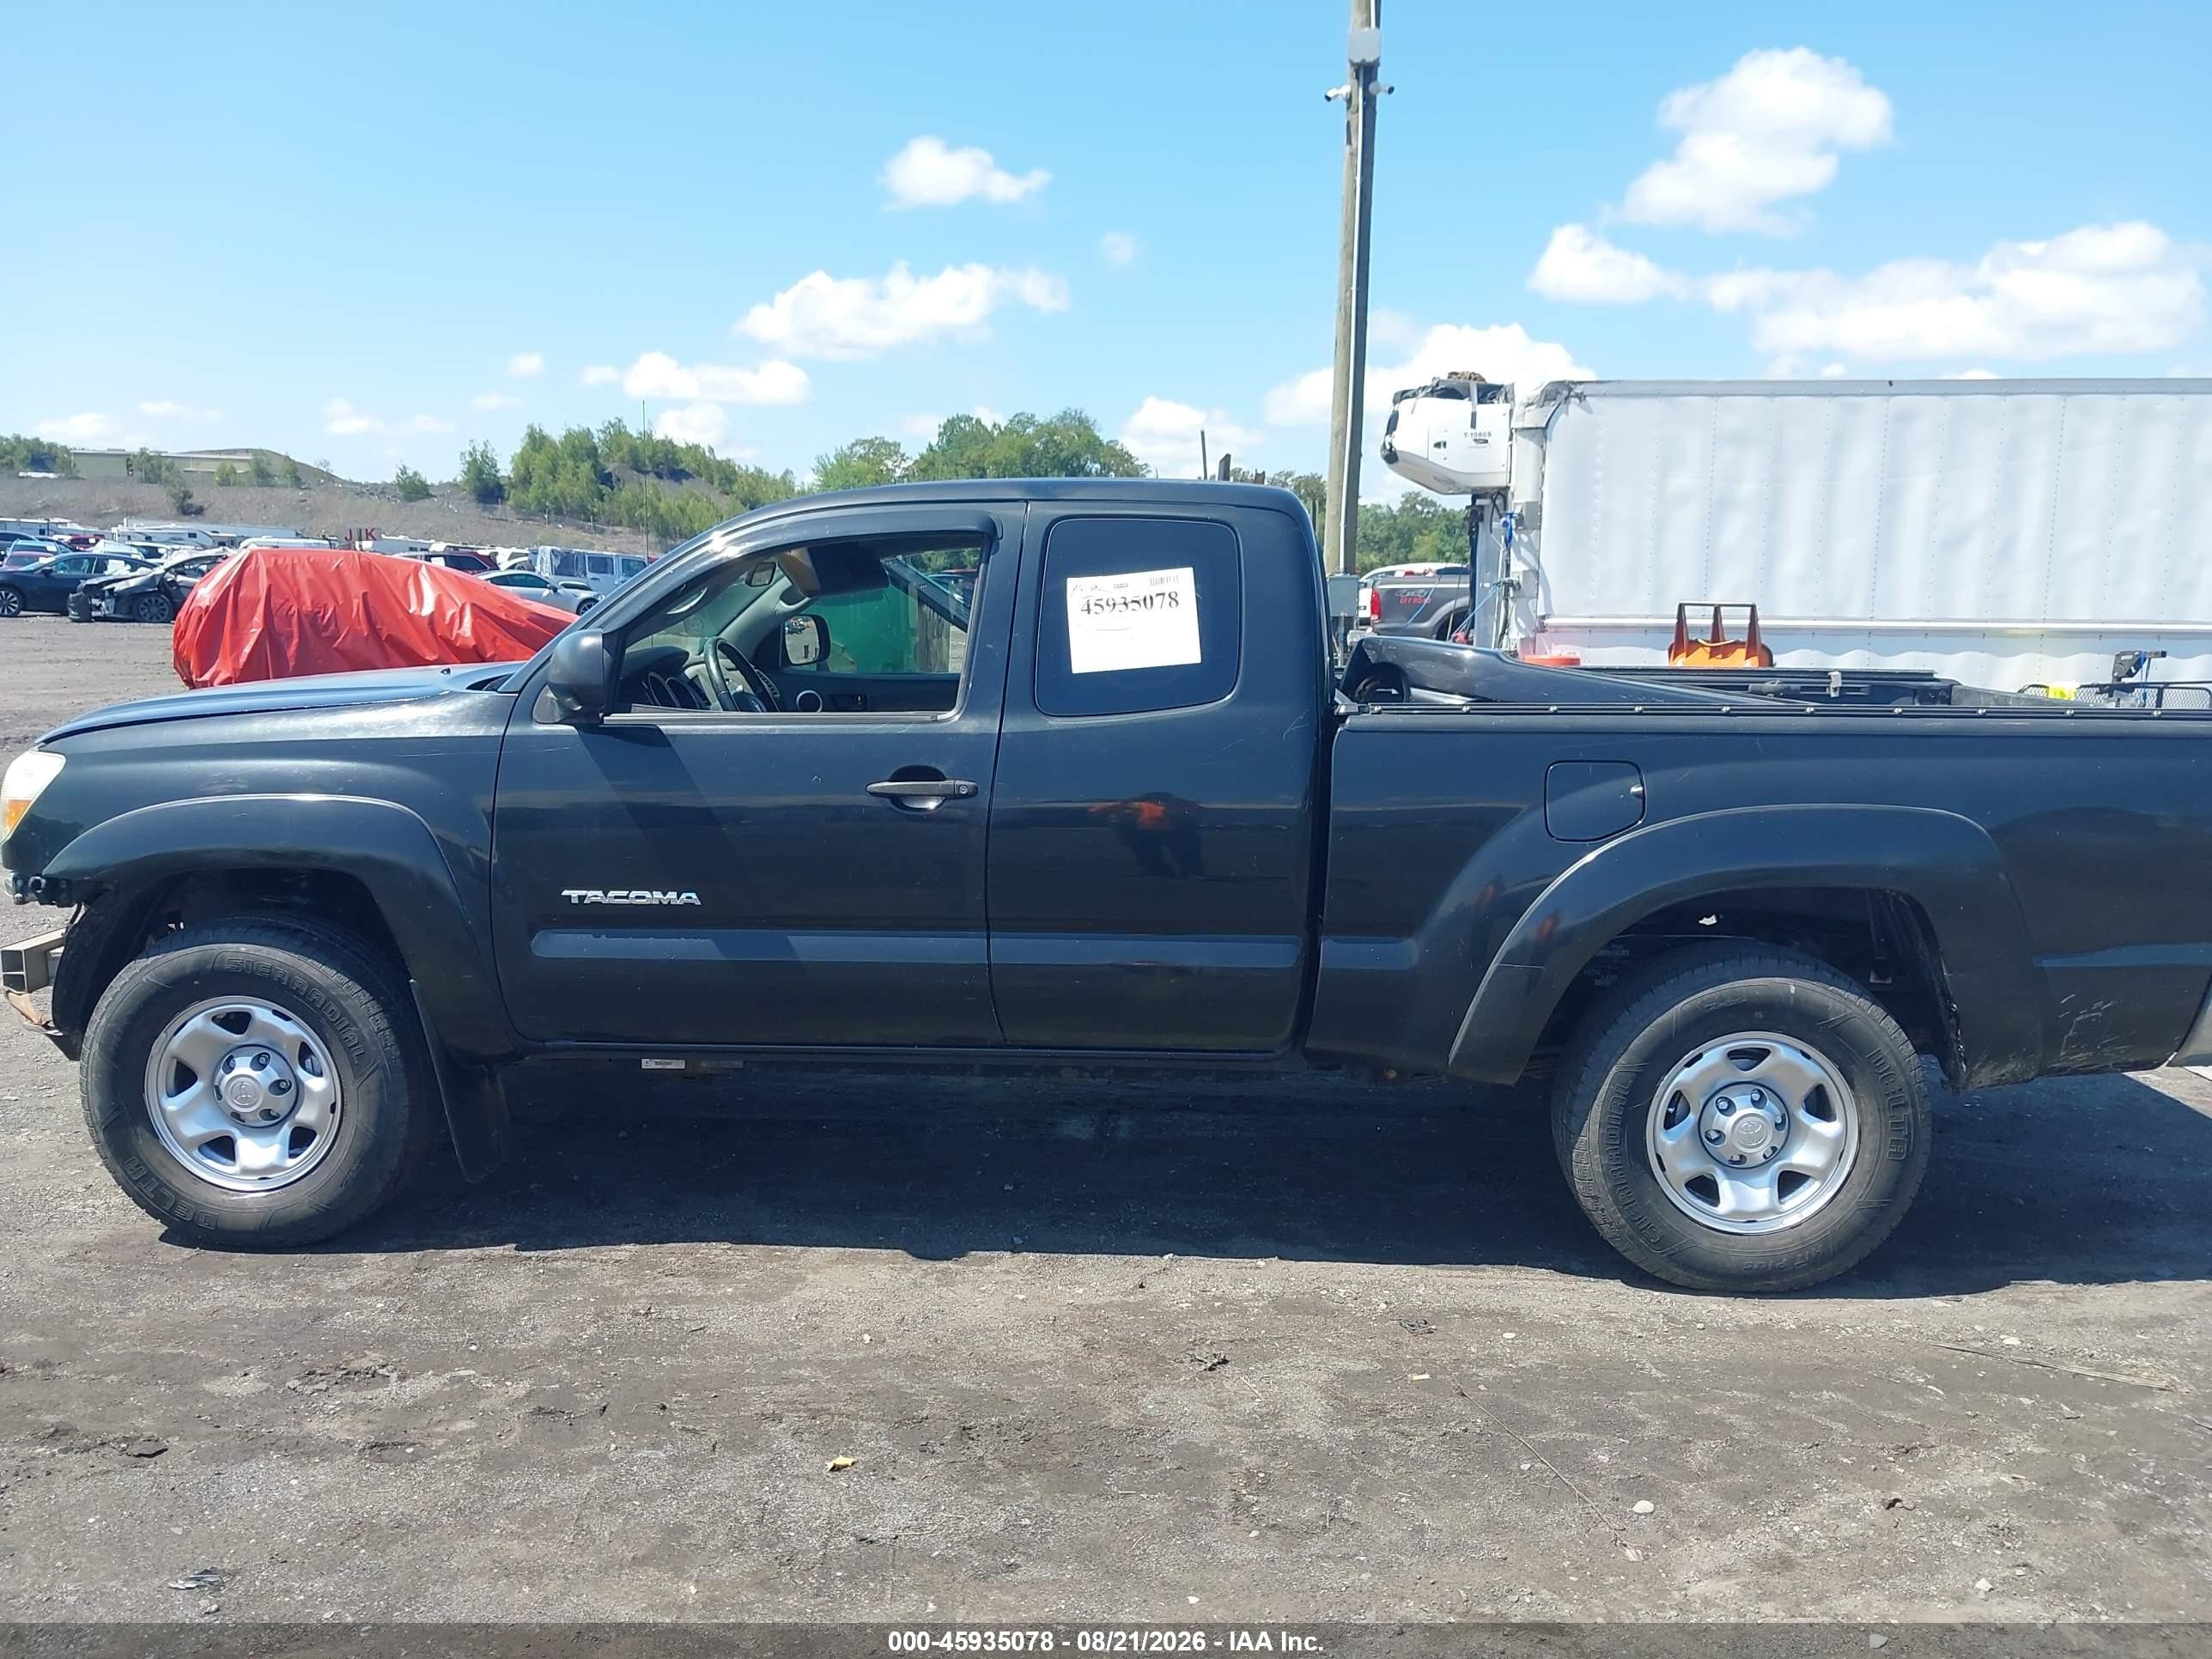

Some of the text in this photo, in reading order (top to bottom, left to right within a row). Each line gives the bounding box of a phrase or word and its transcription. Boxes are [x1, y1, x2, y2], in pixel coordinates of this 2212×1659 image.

[365, 527, 377, 541] K
[1080, 591, 1180, 615] 45935078
[561, 889, 702, 907] TACOMA
